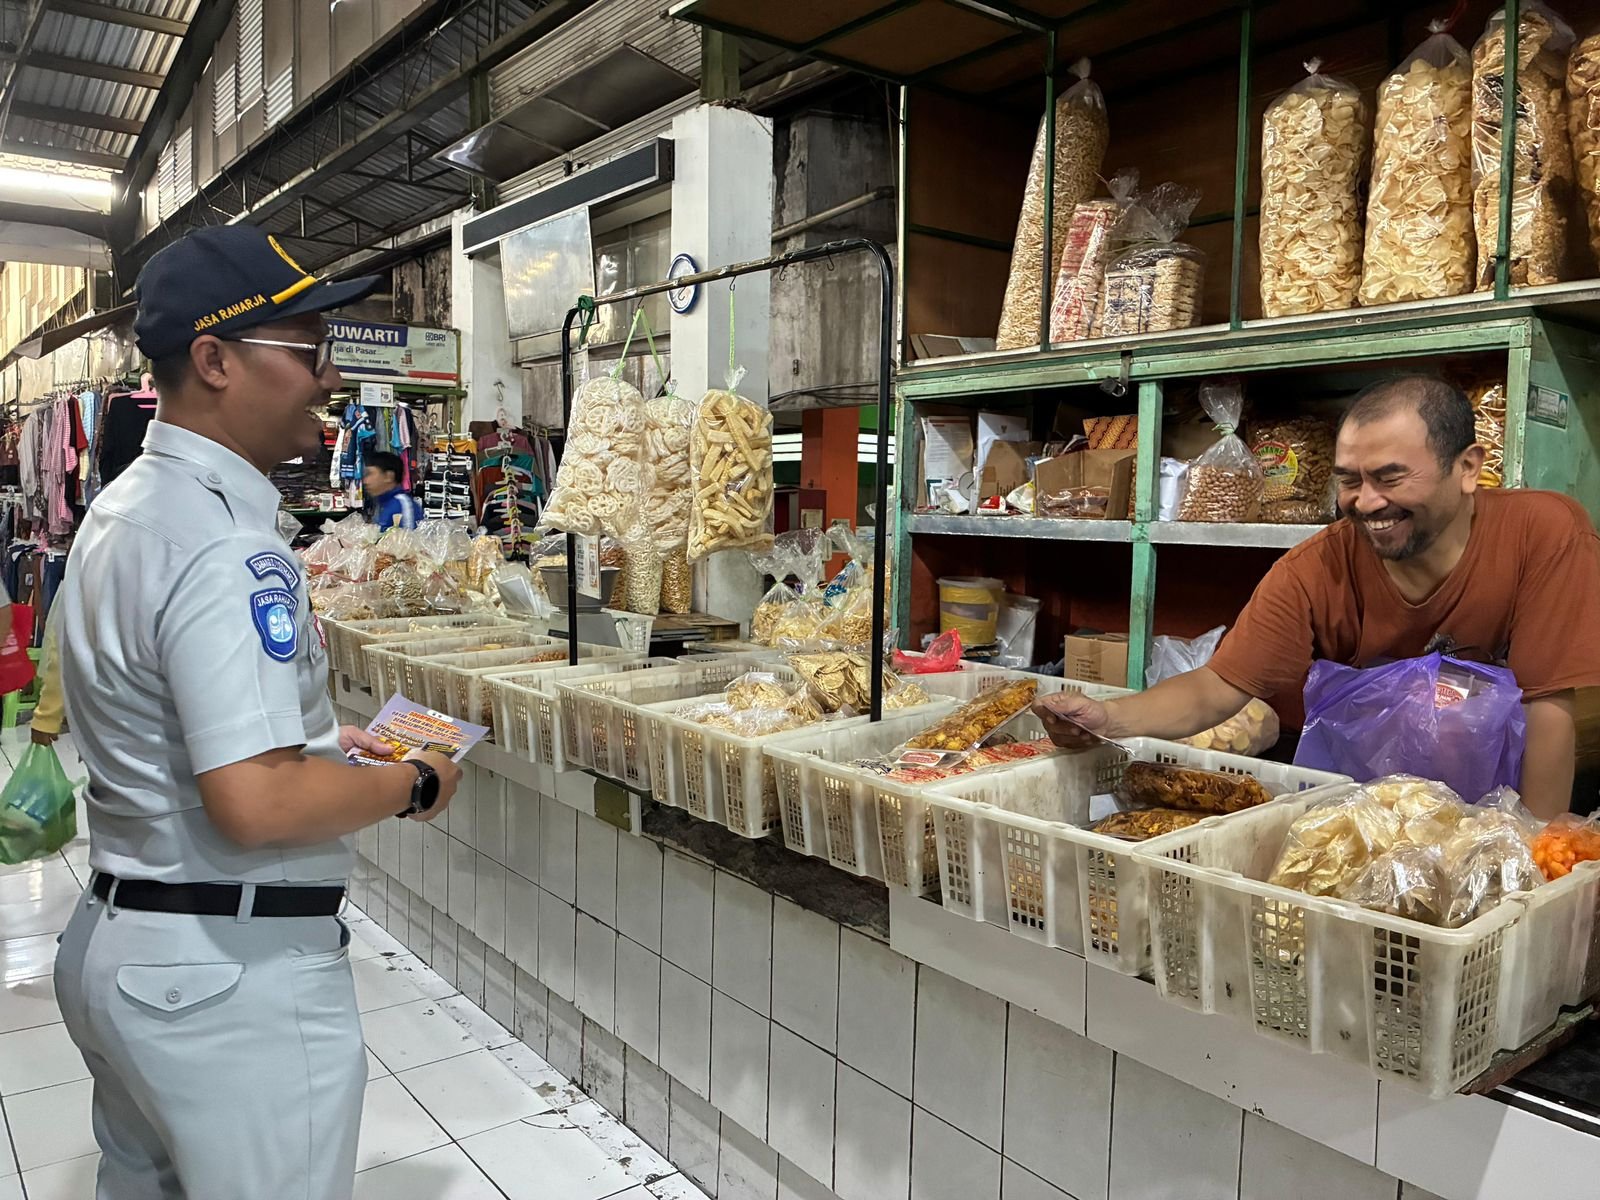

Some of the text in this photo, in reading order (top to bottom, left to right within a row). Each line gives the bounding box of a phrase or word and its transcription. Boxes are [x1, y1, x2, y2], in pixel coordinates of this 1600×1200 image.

[194, 294, 267, 331] JASA RAHARJA
[346, 345, 354, 353] di
[355, 346, 376, 355] Pasar
[257, 595, 273, 607] JASA
